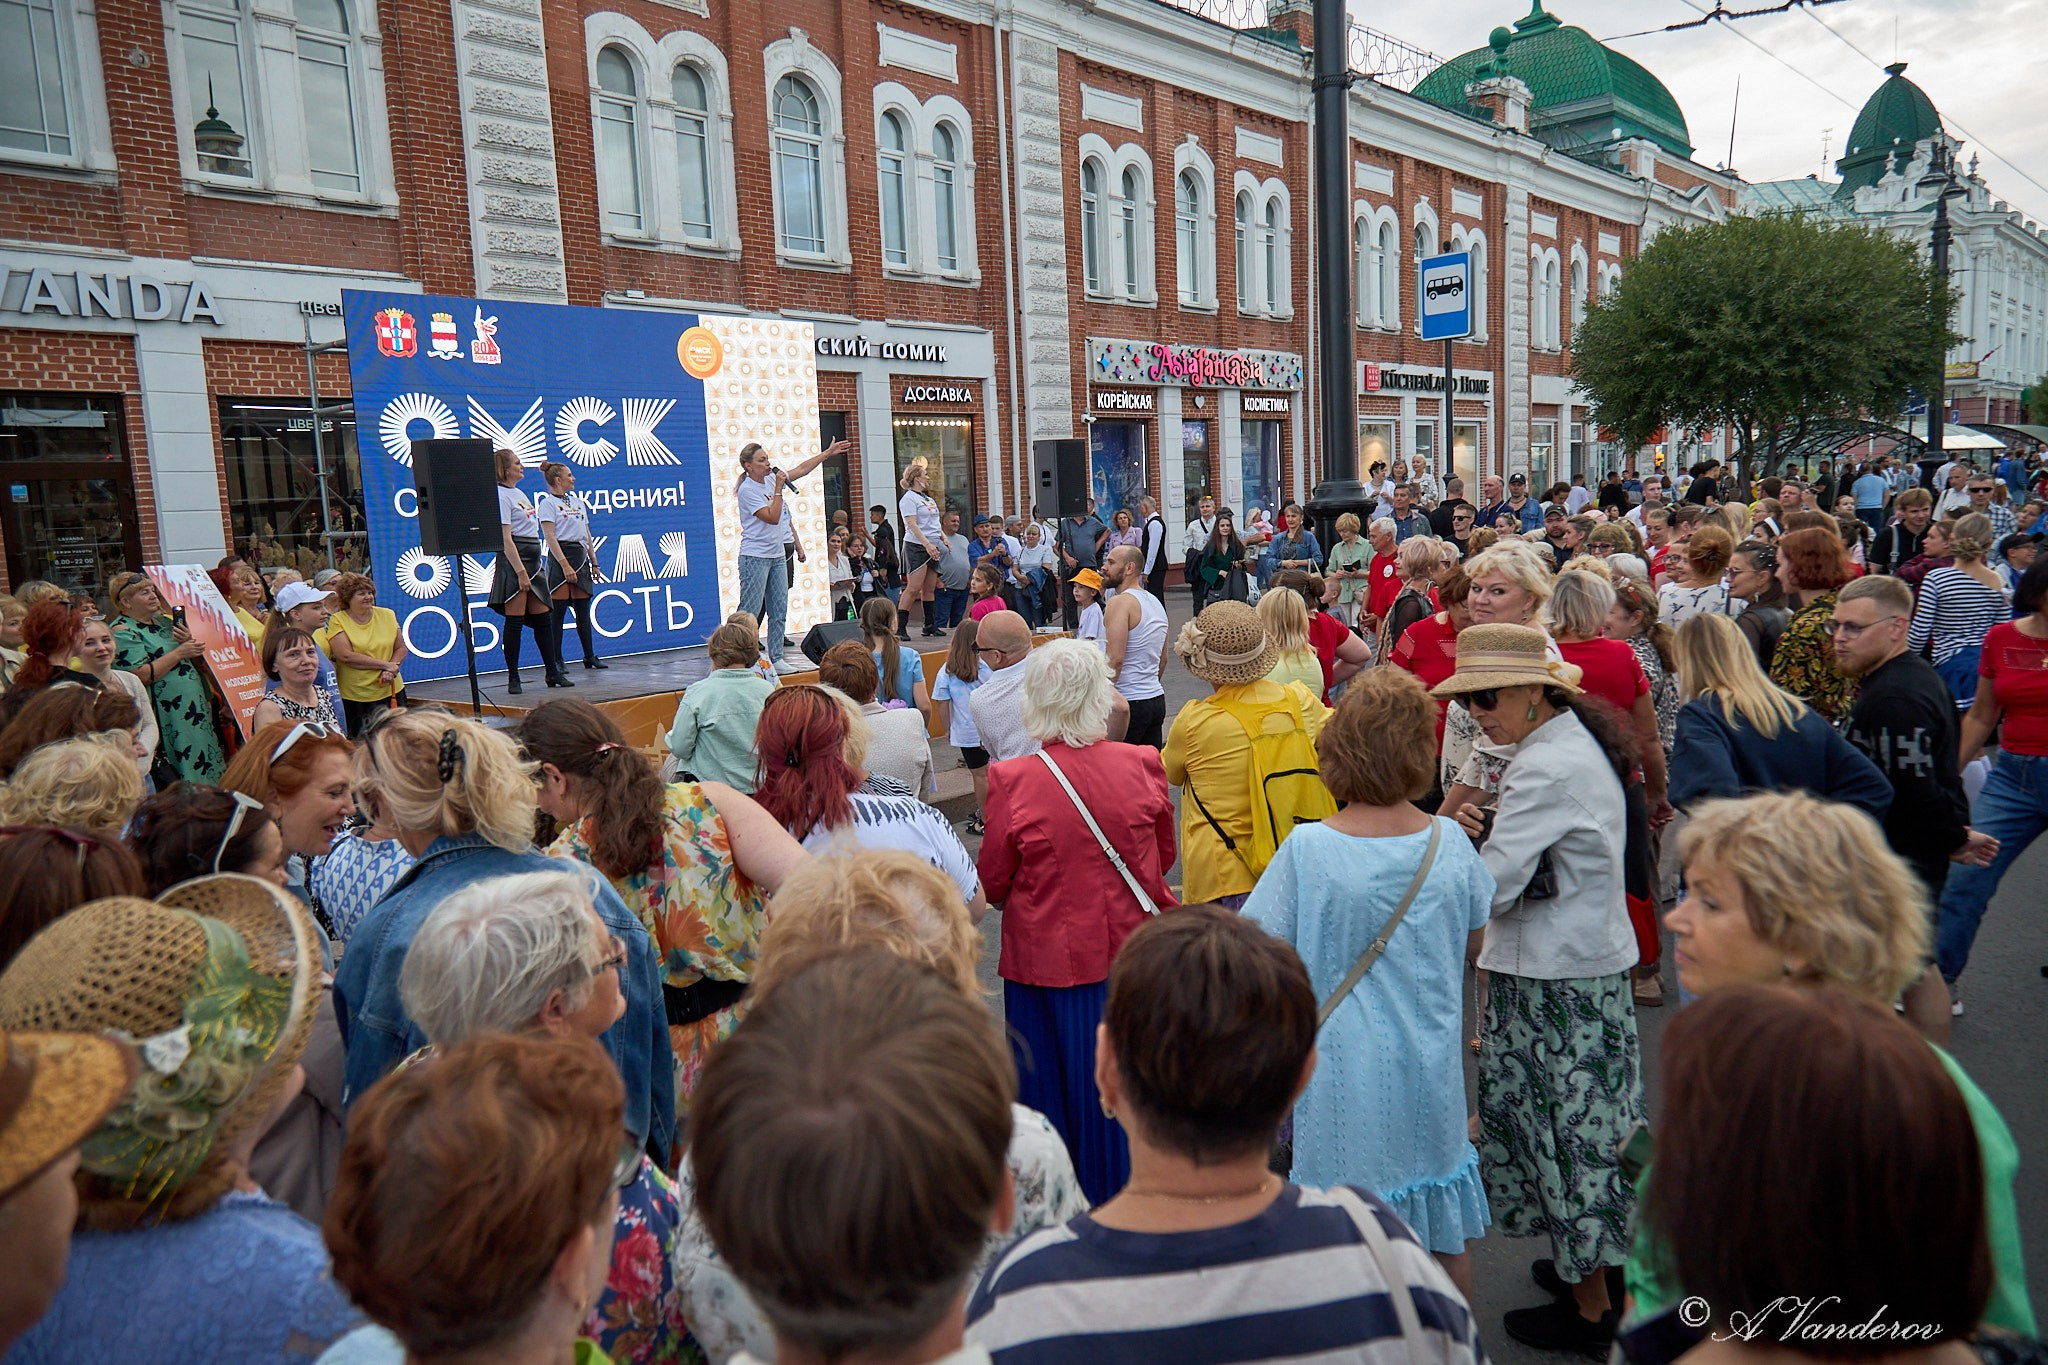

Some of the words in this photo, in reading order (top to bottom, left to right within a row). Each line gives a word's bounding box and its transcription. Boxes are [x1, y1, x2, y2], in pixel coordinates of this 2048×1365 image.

[0, 265, 225, 325] ANDA
[904, 386, 973, 403] ДОСТАВКА
[1097, 390, 1153, 410] КОРЕЙСКАЯ
[1244, 397, 1290, 412] КОСМЕТИКА
[287, 418, 333, 431] ЦВЕЫ
